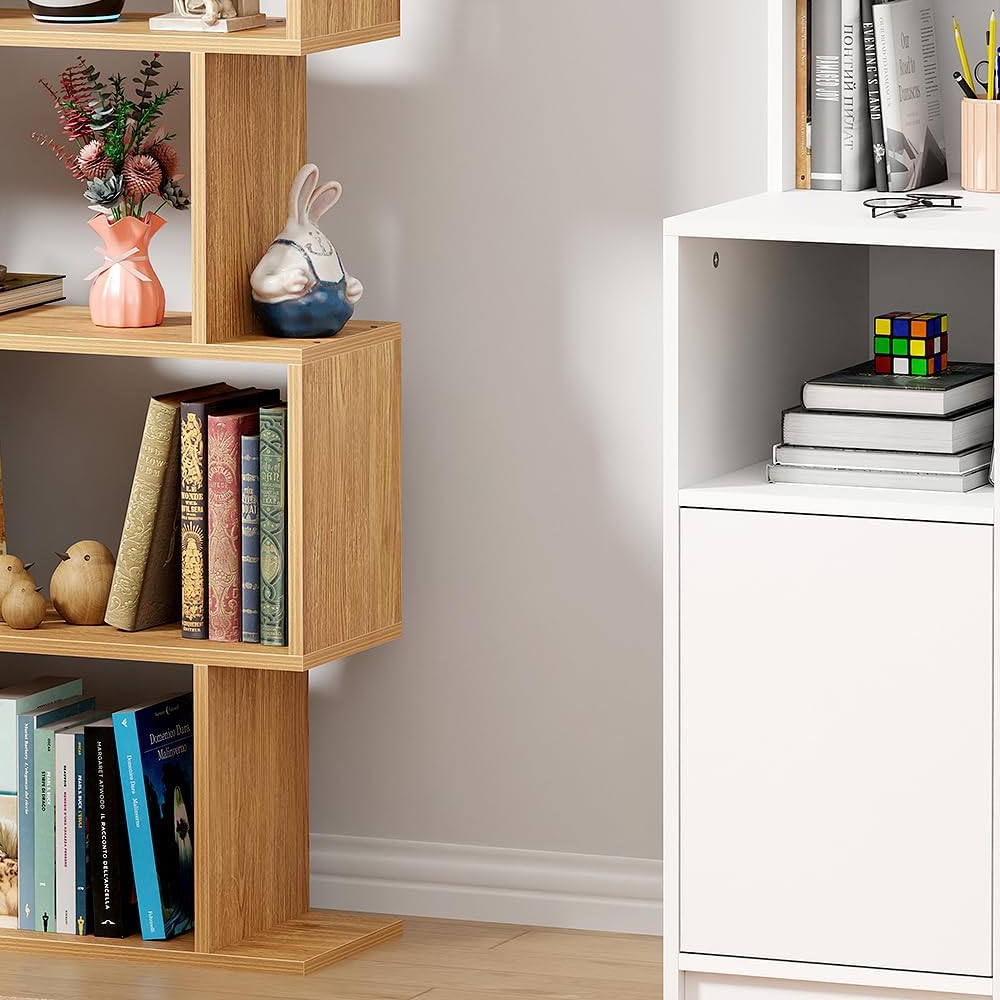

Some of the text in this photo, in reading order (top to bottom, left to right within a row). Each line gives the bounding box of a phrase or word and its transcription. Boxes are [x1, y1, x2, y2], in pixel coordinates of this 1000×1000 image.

[900, 31, 910, 49] Our
[815, 55, 839, 102] DAMAGED JOY
[843, 24, 857, 150] ПОНТИЙ ПИЛАТ
[862, 21, 881, 119] EVENING'S LAND
[149, 727, 176, 745] Domenico
[157, 744, 188, 761] Malinverno
[96, 741, 104, 777] MARGARET
[100, 821, 108, 859] RACCONTO
[102, 861, 110, 910] DELL'ANCELLA
